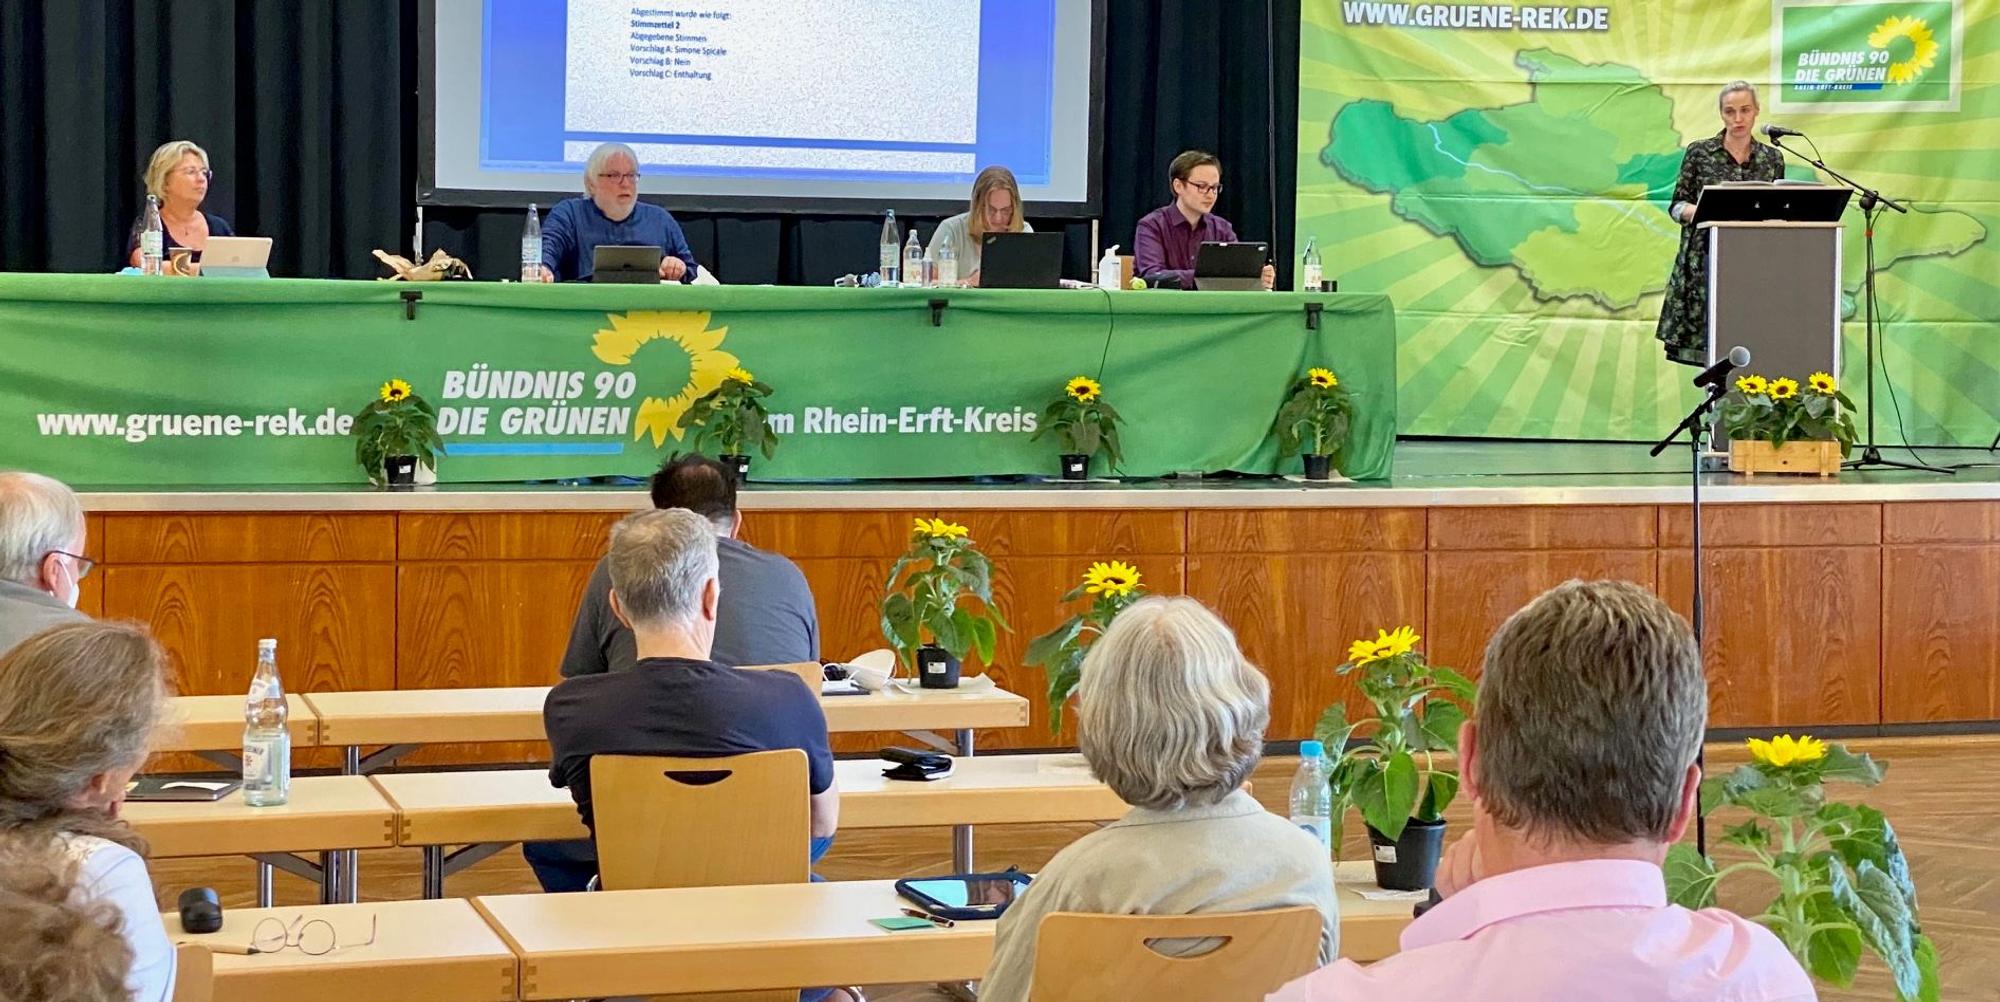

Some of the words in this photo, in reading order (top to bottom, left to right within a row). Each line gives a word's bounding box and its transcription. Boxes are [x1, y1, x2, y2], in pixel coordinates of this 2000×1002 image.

[631, 8, 673, 17] Abgestimmt
[675, 10, 697, 18] wurde
[1344, 2, 1608, 29] WWW.GRUENE-REK.DE
[631, 20, 674, 29] Stimmzettel
[676, 21, 680, 29] 2
[631, 32, 674, 41] Abgegebene
[675, 34, 707, 42] Stimmen
[630, 44, 664, 54] Vorschlag
[674, 46, 700, 54] Simone
[630, 57, 664, 66] Vorschlag
[674, 58, 691, 66] Nein
[1798, 50, 1864, 66] BÜNDNIS
[1869, 51, 1889, 64] 90
[629, 69, 664, 79] Vorschlag
[674, 70, 712, 80] Enthaltung
[1795, 68, 1821, 83] DIE
[1825, 66, 1886, 82] GRÜNEN
[442, 363, 585, 399] BÜNDNIS
[594, 371, 637, 399] 90
[37, 408, 354, 443] www.gruene-rek.de
[436, 407, 489, 435] DIE
[500, 400, 631, 435] GRÜNEN
[804, 406, 1037, 434] Rhein-Erft-Kreis
